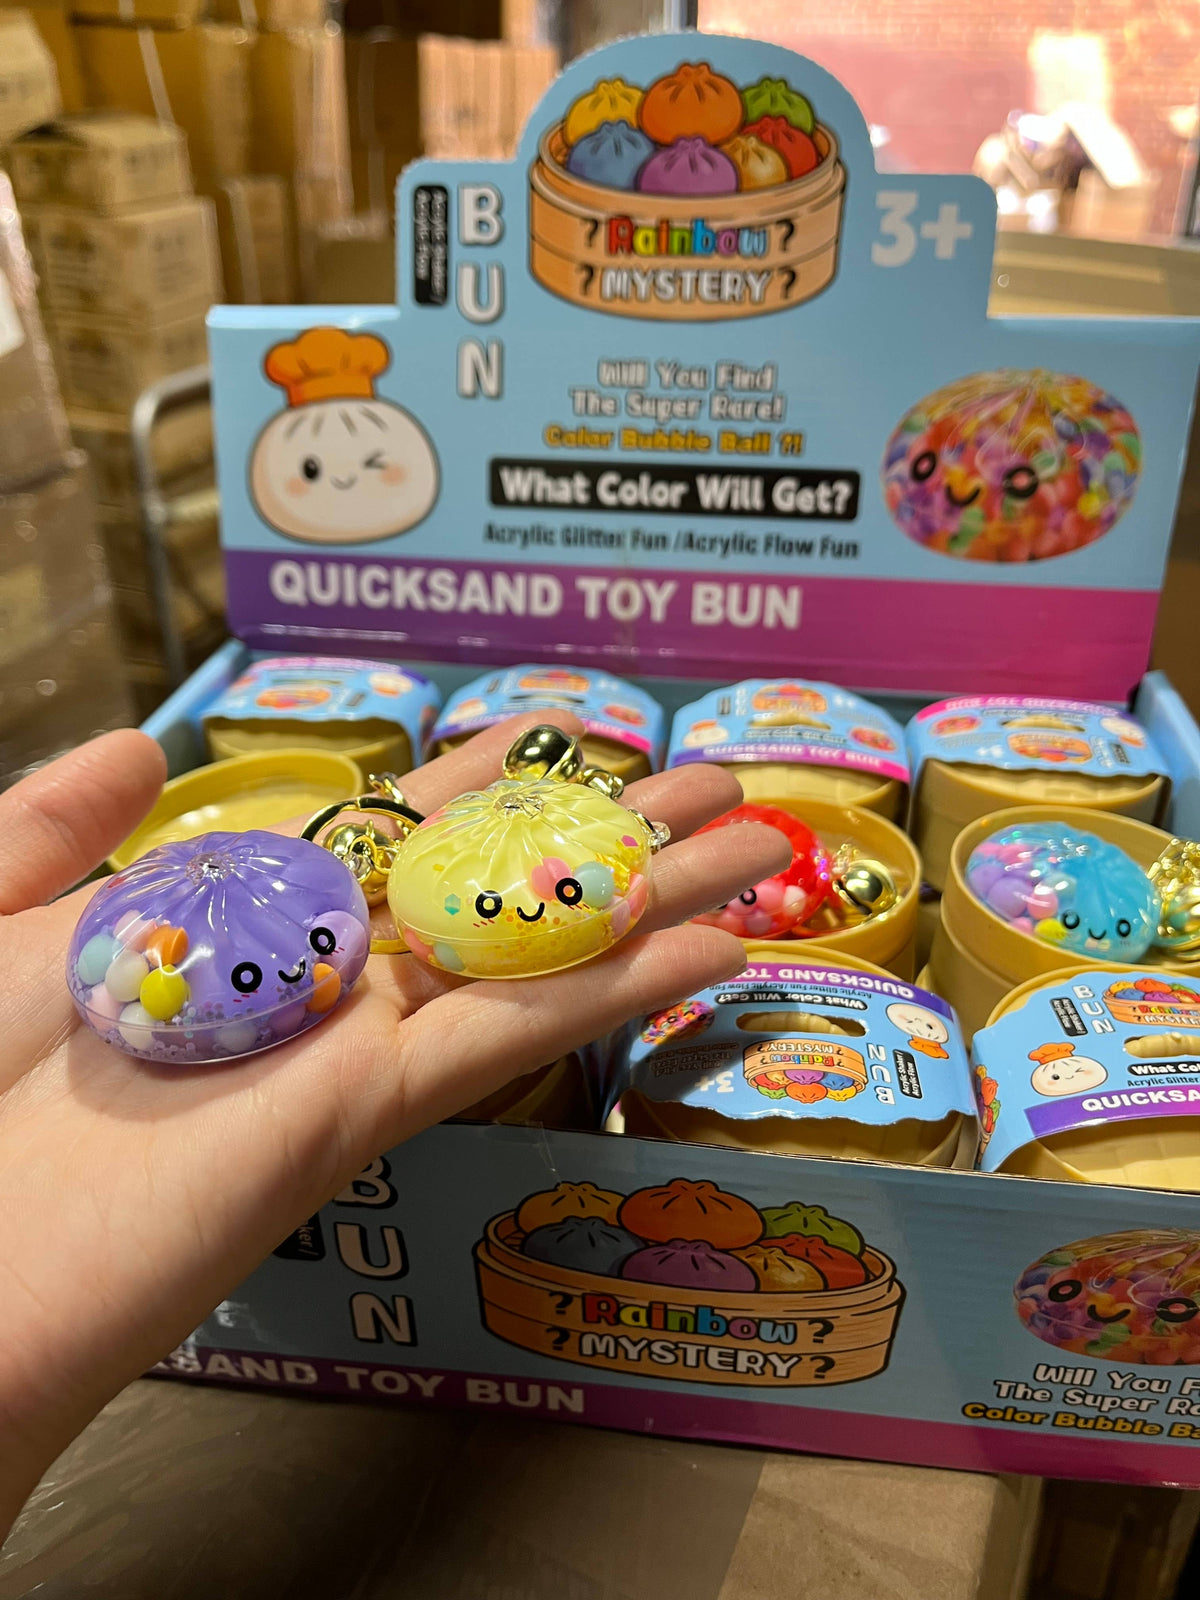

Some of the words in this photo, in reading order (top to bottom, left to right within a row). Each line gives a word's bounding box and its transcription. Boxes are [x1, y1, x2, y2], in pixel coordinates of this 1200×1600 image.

[607, 215, 768, 257] Rainbow
[871, 190, 972, 268] 3+
[456, 183, 505, 399] BUN
[602, 268, 771, 302] MYSTERY
[599, 359, 647, 388] Will
[656, 360, 708, 389] You
[716, 361, 777, 392] Find
[569, 387, 618, 416] The
[626, 390, 703, 425] Super
[710, 393, 786, 421] Rare!
[545, 424, 614, 448] Color
[620, 426, 711, 452] Bubble
[719, 430, 771, 454] Ball
[499, 466, 591, 505] What
[596, 471, 688, 509] Color
[696, 473, 764, 511] Will
[771, 477, 854, 516] Get?
[484, 522, 556, 550] Acrylic
[560, 523, 626, 549] Glitter
[631, 528, 668, 551] Fun
[762, 533, 814, 557] Flow
[818, 537, 861, 559] Fun
[268, 559, 563, 618] QUICKSAND
[574, 577, 679, 624] TOY
[689, 581, 802, 631] BUN
[717, 993, 750, 1003] Get?
[754, 992, 781, 1001] Will
[778, 968, 915, 999] QUICKSAND
[786, 992, 823, 1003] Color
[825, 996, 865, 1009] What
[768, 1043, 833, 1054] MYSTERY
[770, 1054, 835, 1066] Rainbow
[1127, 1077, 1165, 1087] Acrylic
[1166, 1076, 1199, 1084] Glitter
[1131, 1064, 1176, 1075] What
[581, 1292, 798, 1345] Rainbow
[579, 1331, 801, 1379] MYSTERY
[335, 1366, 444, 1398] TOY
[466, 1379, 585, 1413] BUN
[1034, 1364, 1096, 1388] Will
[1108, 1371, 1171, 1394] You
[993, 1380, 1052, 1402] The
[1063, 1388, 1159, 1413] Super
[962, 1402, 1048, 1425] Color
[1052, 1411, 1163, 1436] Bubble
